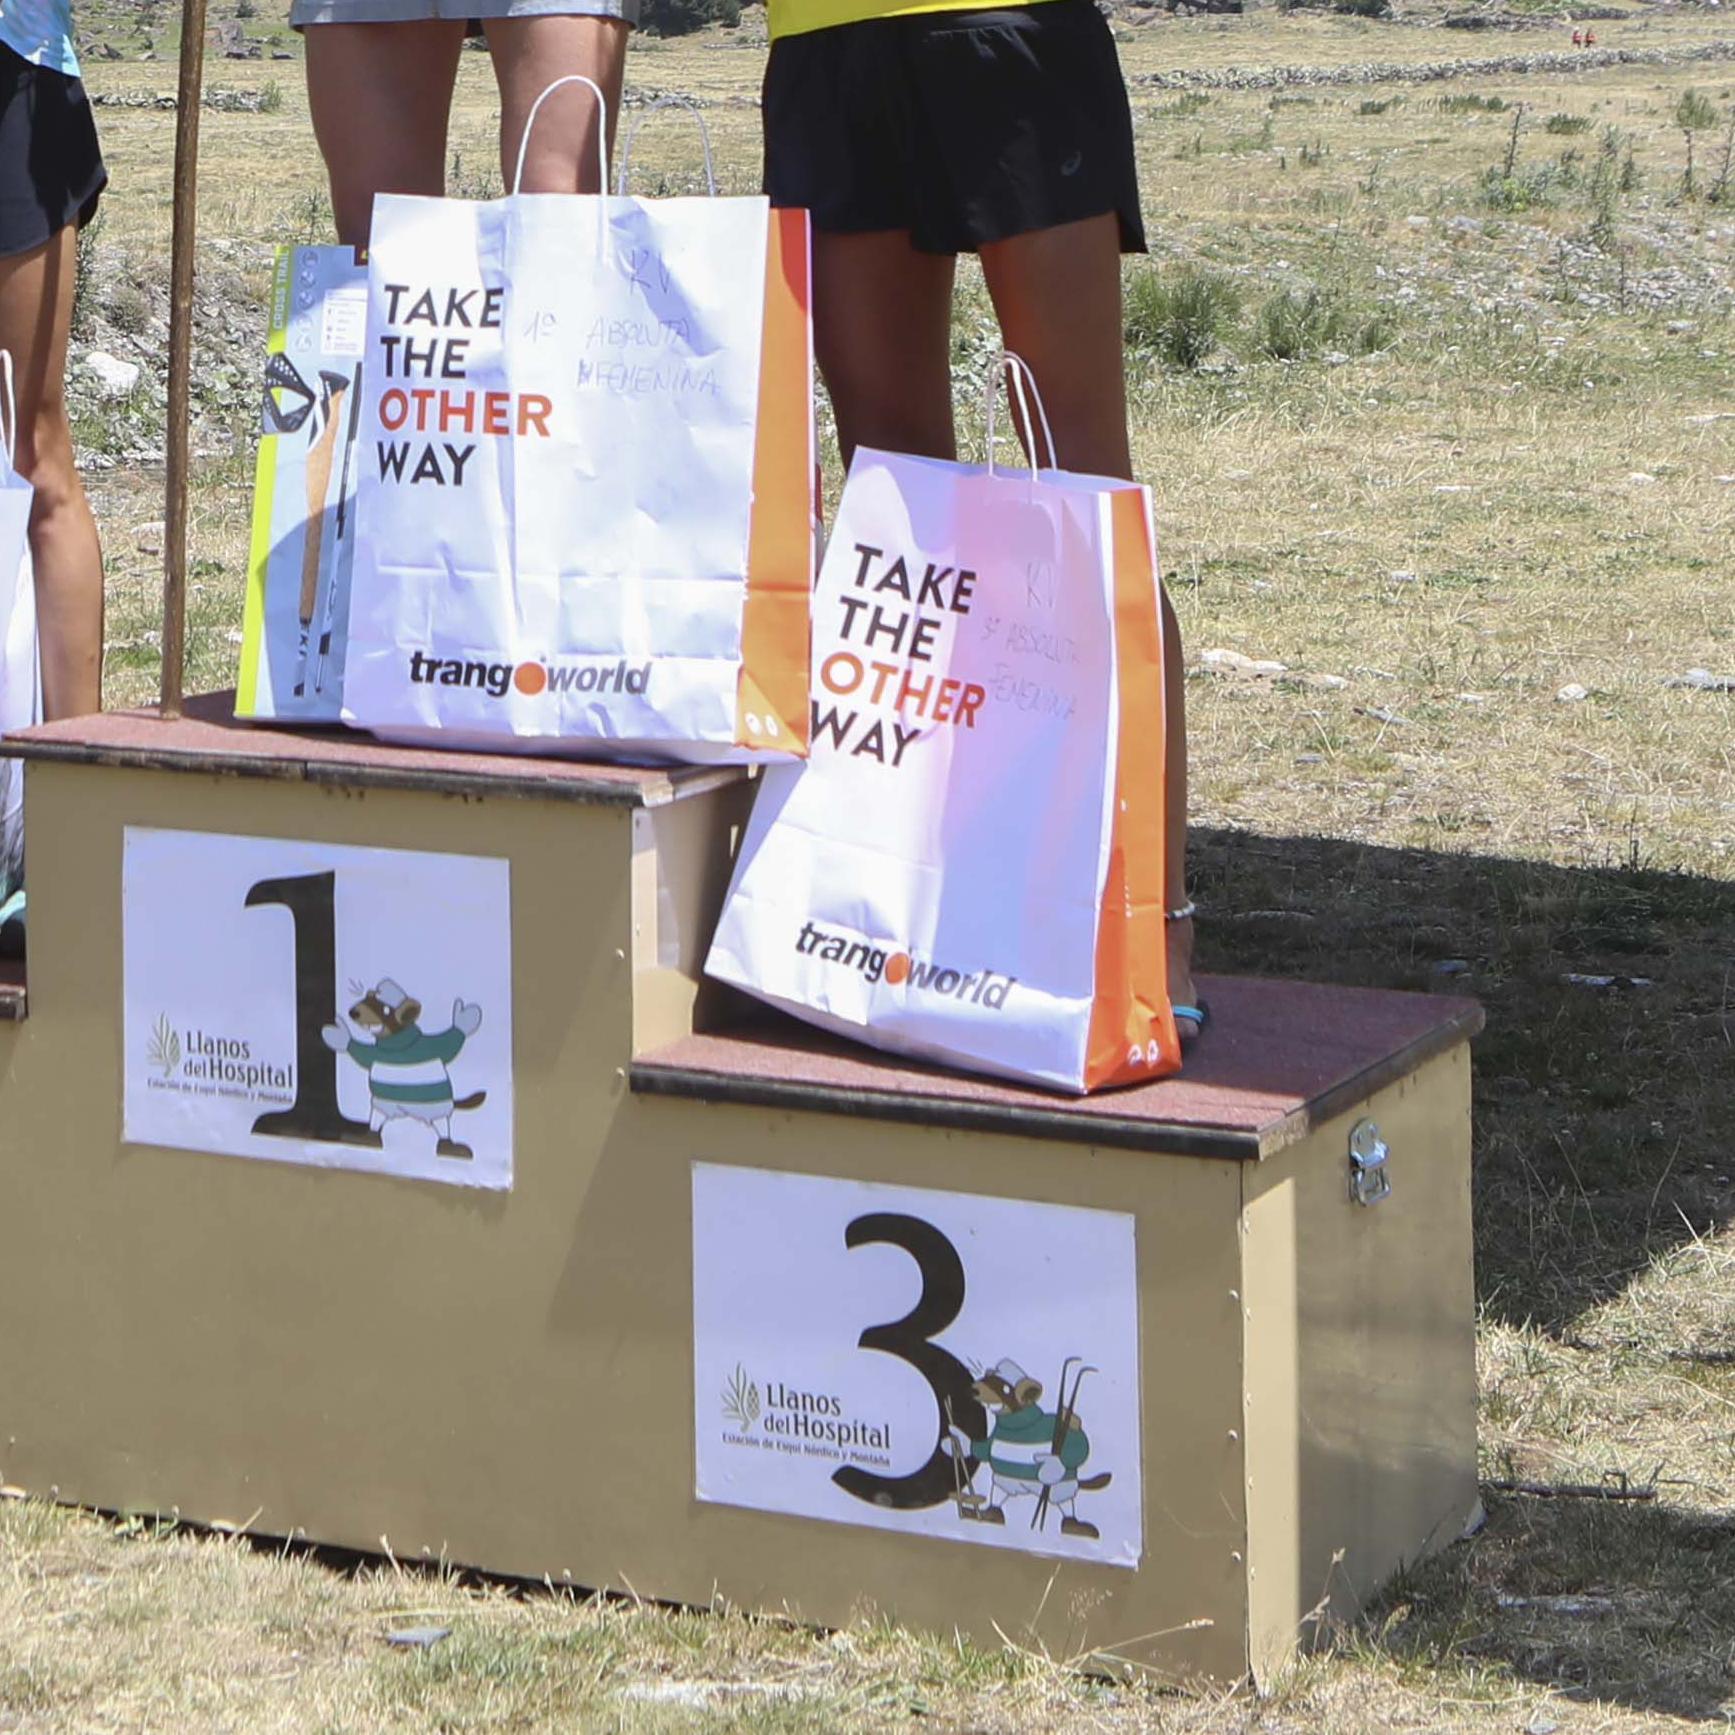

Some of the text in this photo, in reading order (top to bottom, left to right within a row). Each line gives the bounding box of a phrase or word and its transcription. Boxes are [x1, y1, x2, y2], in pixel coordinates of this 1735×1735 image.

[273, 287, 287, 330] CROSS
[384, 284, 504, 329] TAKE
[380, 337, 467, 379] THE
[379, 389, 553, 437] OTHER
[377, 442, 476, 487] WAY
[853, 544, 977, 615] TAKE
[838, 597, 941, 662] THE
[821, 652, 986, 730] OTHER
[810, 700, 922, 768] WAY
[244, 869, 384, 1150] 1
[186, 1030, 250, 1059] Llanos
[831, 1212, 988, 1510] 3
[766, 1383, 841, 1417] Llanos
